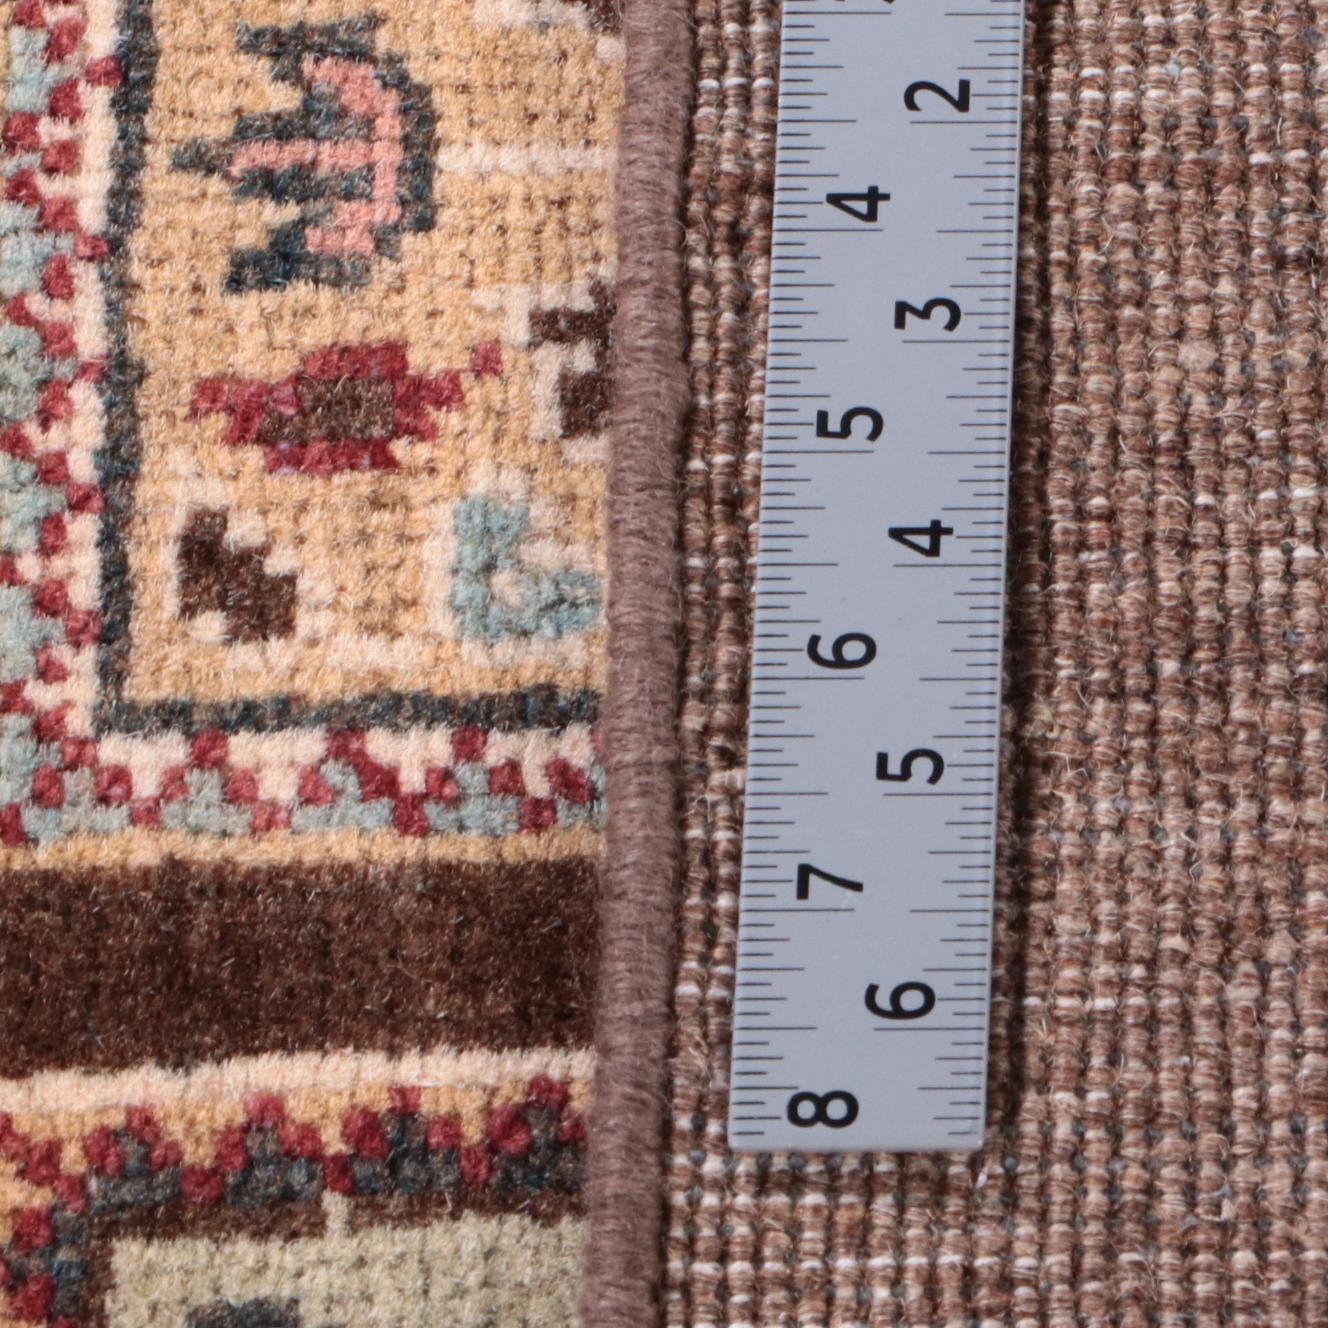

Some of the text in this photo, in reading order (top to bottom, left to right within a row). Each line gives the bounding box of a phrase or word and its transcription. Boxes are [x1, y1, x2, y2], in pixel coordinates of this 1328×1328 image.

[902, 78, 972, 114] 2
[824, 184, 892, 224] 4
[893, 296, 963, 333] 3
[814, 405, 885, 443] 5
[887, 518, 955, 559] 4
[805, 631, 878, 671] 6
[874, 747, 946, 786] 5
[795, 862, 865, 902] 7
[863, 980, 937, 1021] 6
[785, 1089, 861, 1130] 8
